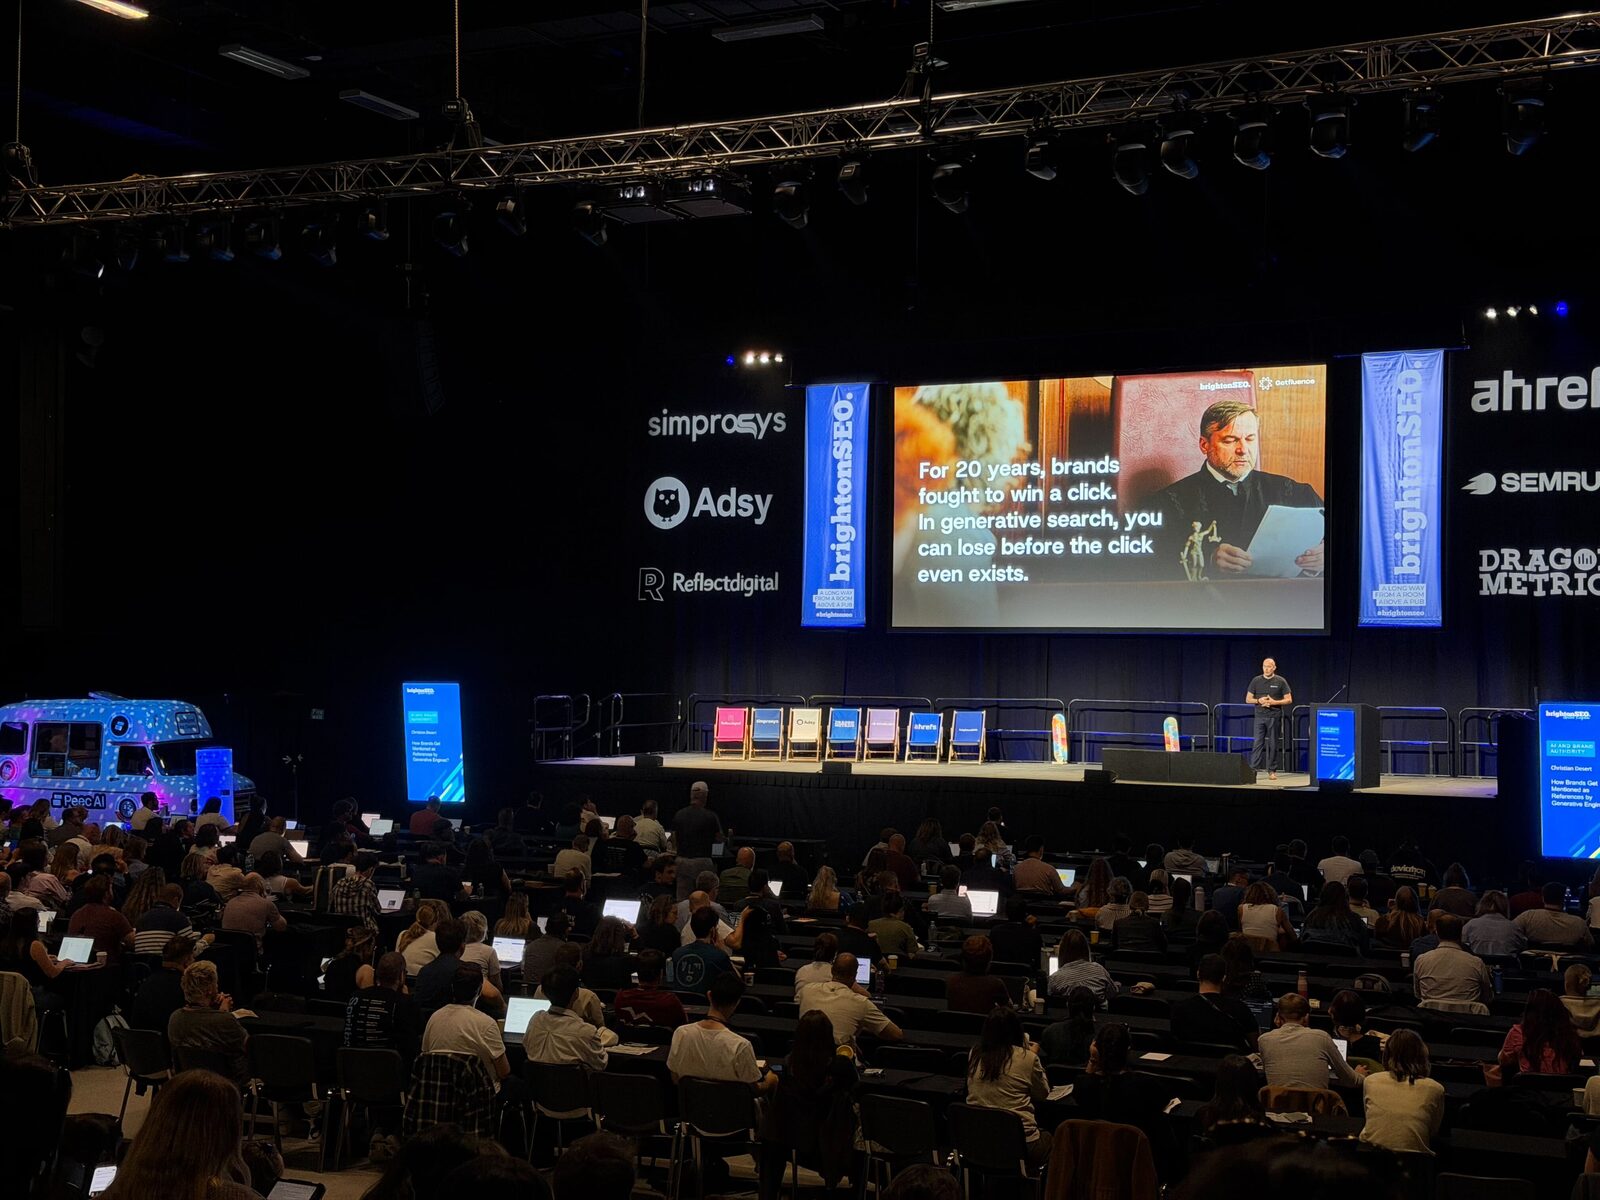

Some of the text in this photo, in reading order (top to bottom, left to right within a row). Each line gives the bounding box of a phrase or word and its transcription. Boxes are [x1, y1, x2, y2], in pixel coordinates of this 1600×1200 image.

[648, 408, 787, 442] simprosys
[918, 455, 1120, 482] For 20 years, brands
[1393, 359, 1427, 576] brightonSEO.
[829, 391, 856, 582] brightonSEO.
[918, 482, 1117, 508] fought to win a click.
[692, 486, 774, 525] Adsy
[918, 509, 1163, 535] In generative search, you
[918, 535, 1154, 557] can lose before the click
[1479, 548, 1600, 572] DRAGO
[917, 564, 1029, 583] even exists.
[64, 794, 106, 808] Peec AI
